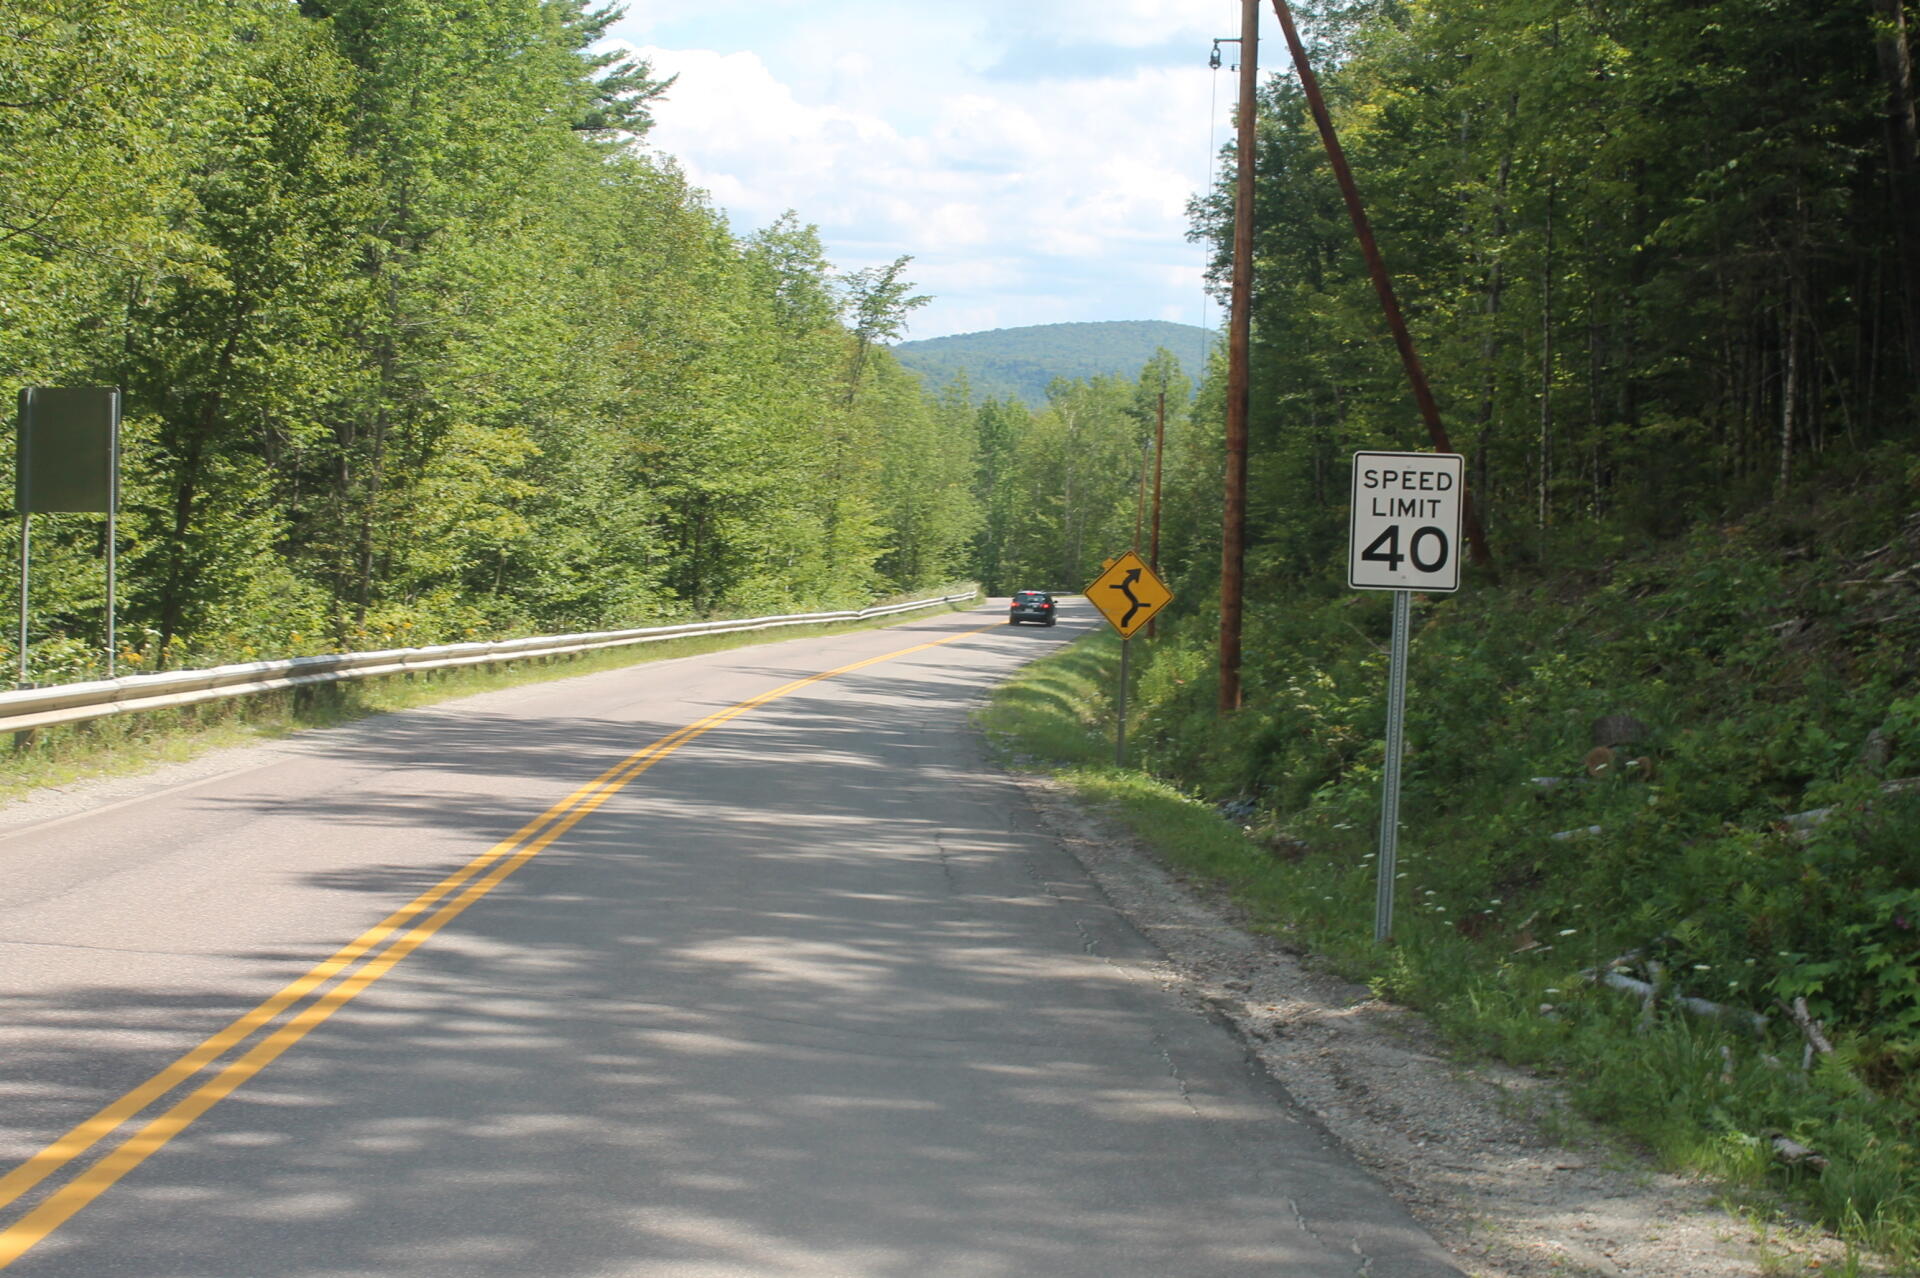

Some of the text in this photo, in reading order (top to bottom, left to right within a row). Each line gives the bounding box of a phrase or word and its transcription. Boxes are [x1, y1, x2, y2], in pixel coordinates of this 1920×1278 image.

[1363, 469, 1453, 491] SPEED
[1372, 497, 1441, 518] LIMIT
[1361, 524, 1449, 573] 40
